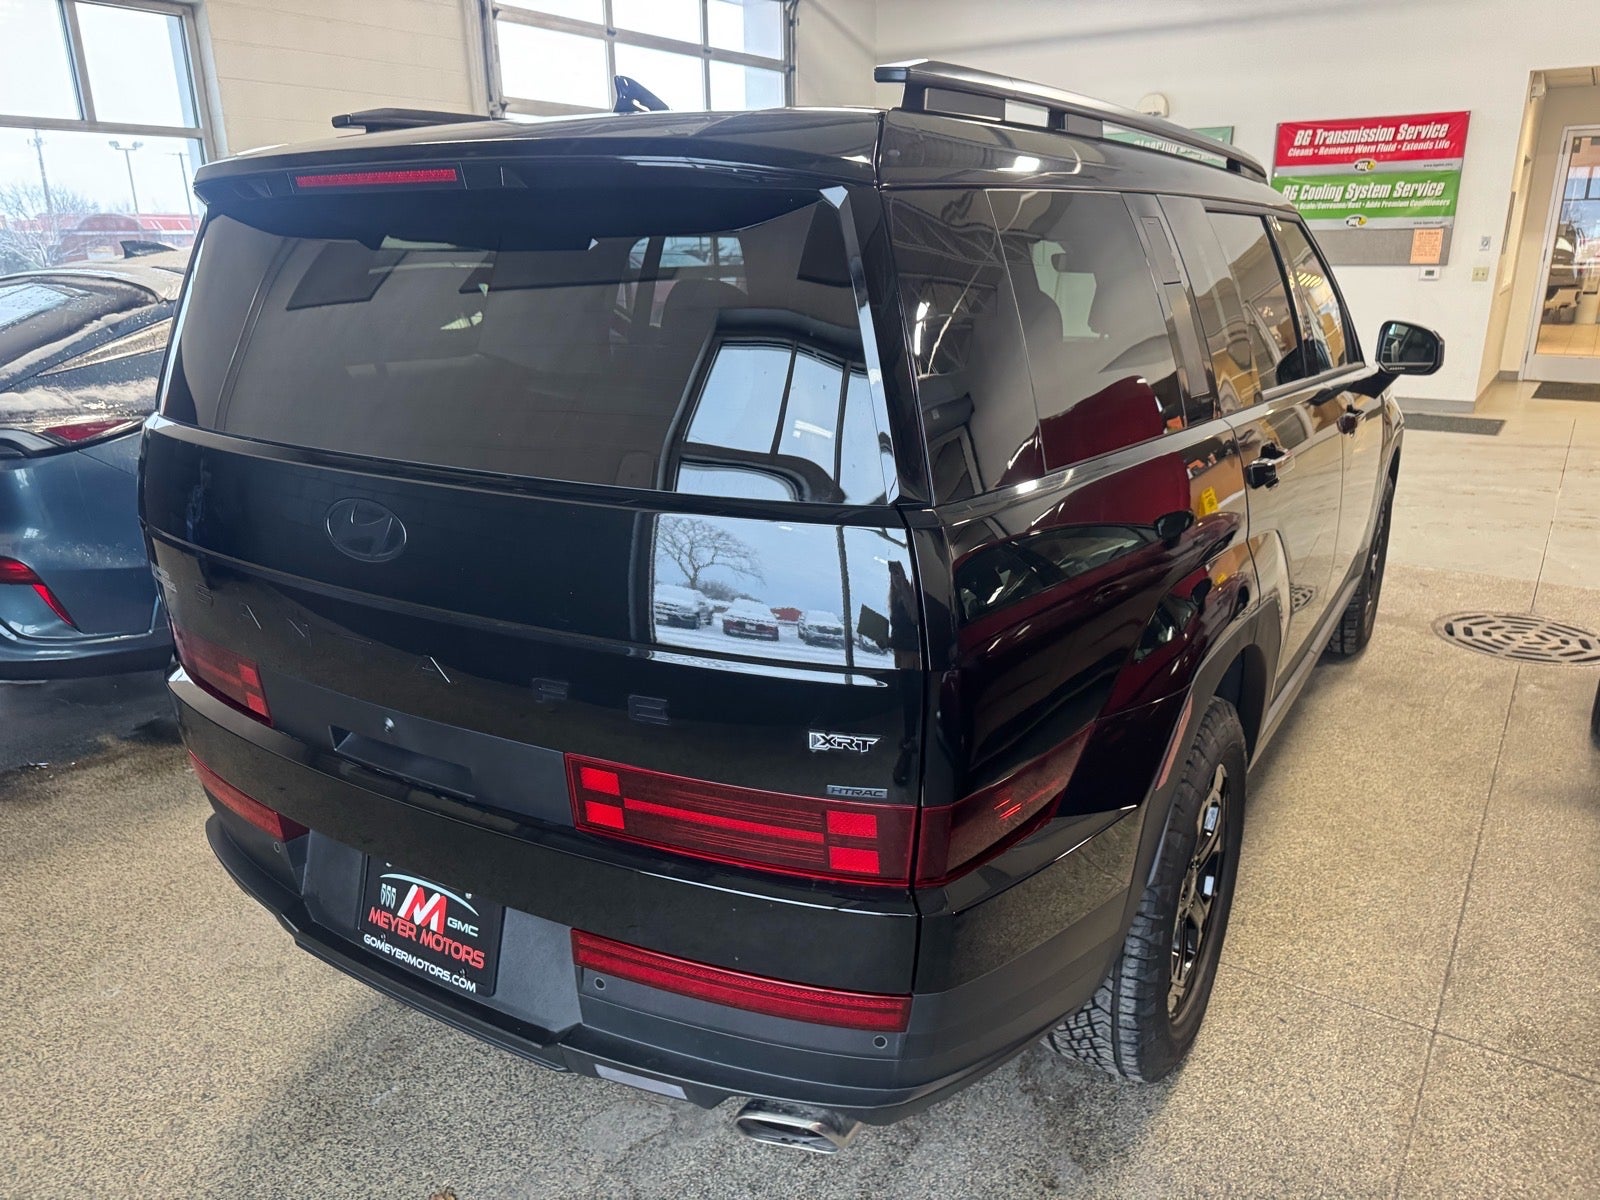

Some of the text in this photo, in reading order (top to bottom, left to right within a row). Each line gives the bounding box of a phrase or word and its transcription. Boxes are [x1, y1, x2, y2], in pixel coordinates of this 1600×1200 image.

[1294, 121, 1449, 146] BG Transmission Service
[1288, 140, 1450, 157] Cleans Removes Worn Fluid Extends Life
[1300, 184, 1344, 202] Cooling
[1345, 182, 1392, 201] System
[1393, 181, 1445, 198] Service
[808, 731, 881, 753] XRT
[830, 786, 884, 798] HTRAC
[368, 906, 485, 969] MEYER MOTORS
[447, 918, 480, 938] GMC
[363, 933, 477, 993] GOMEYERMOTORS.COM
